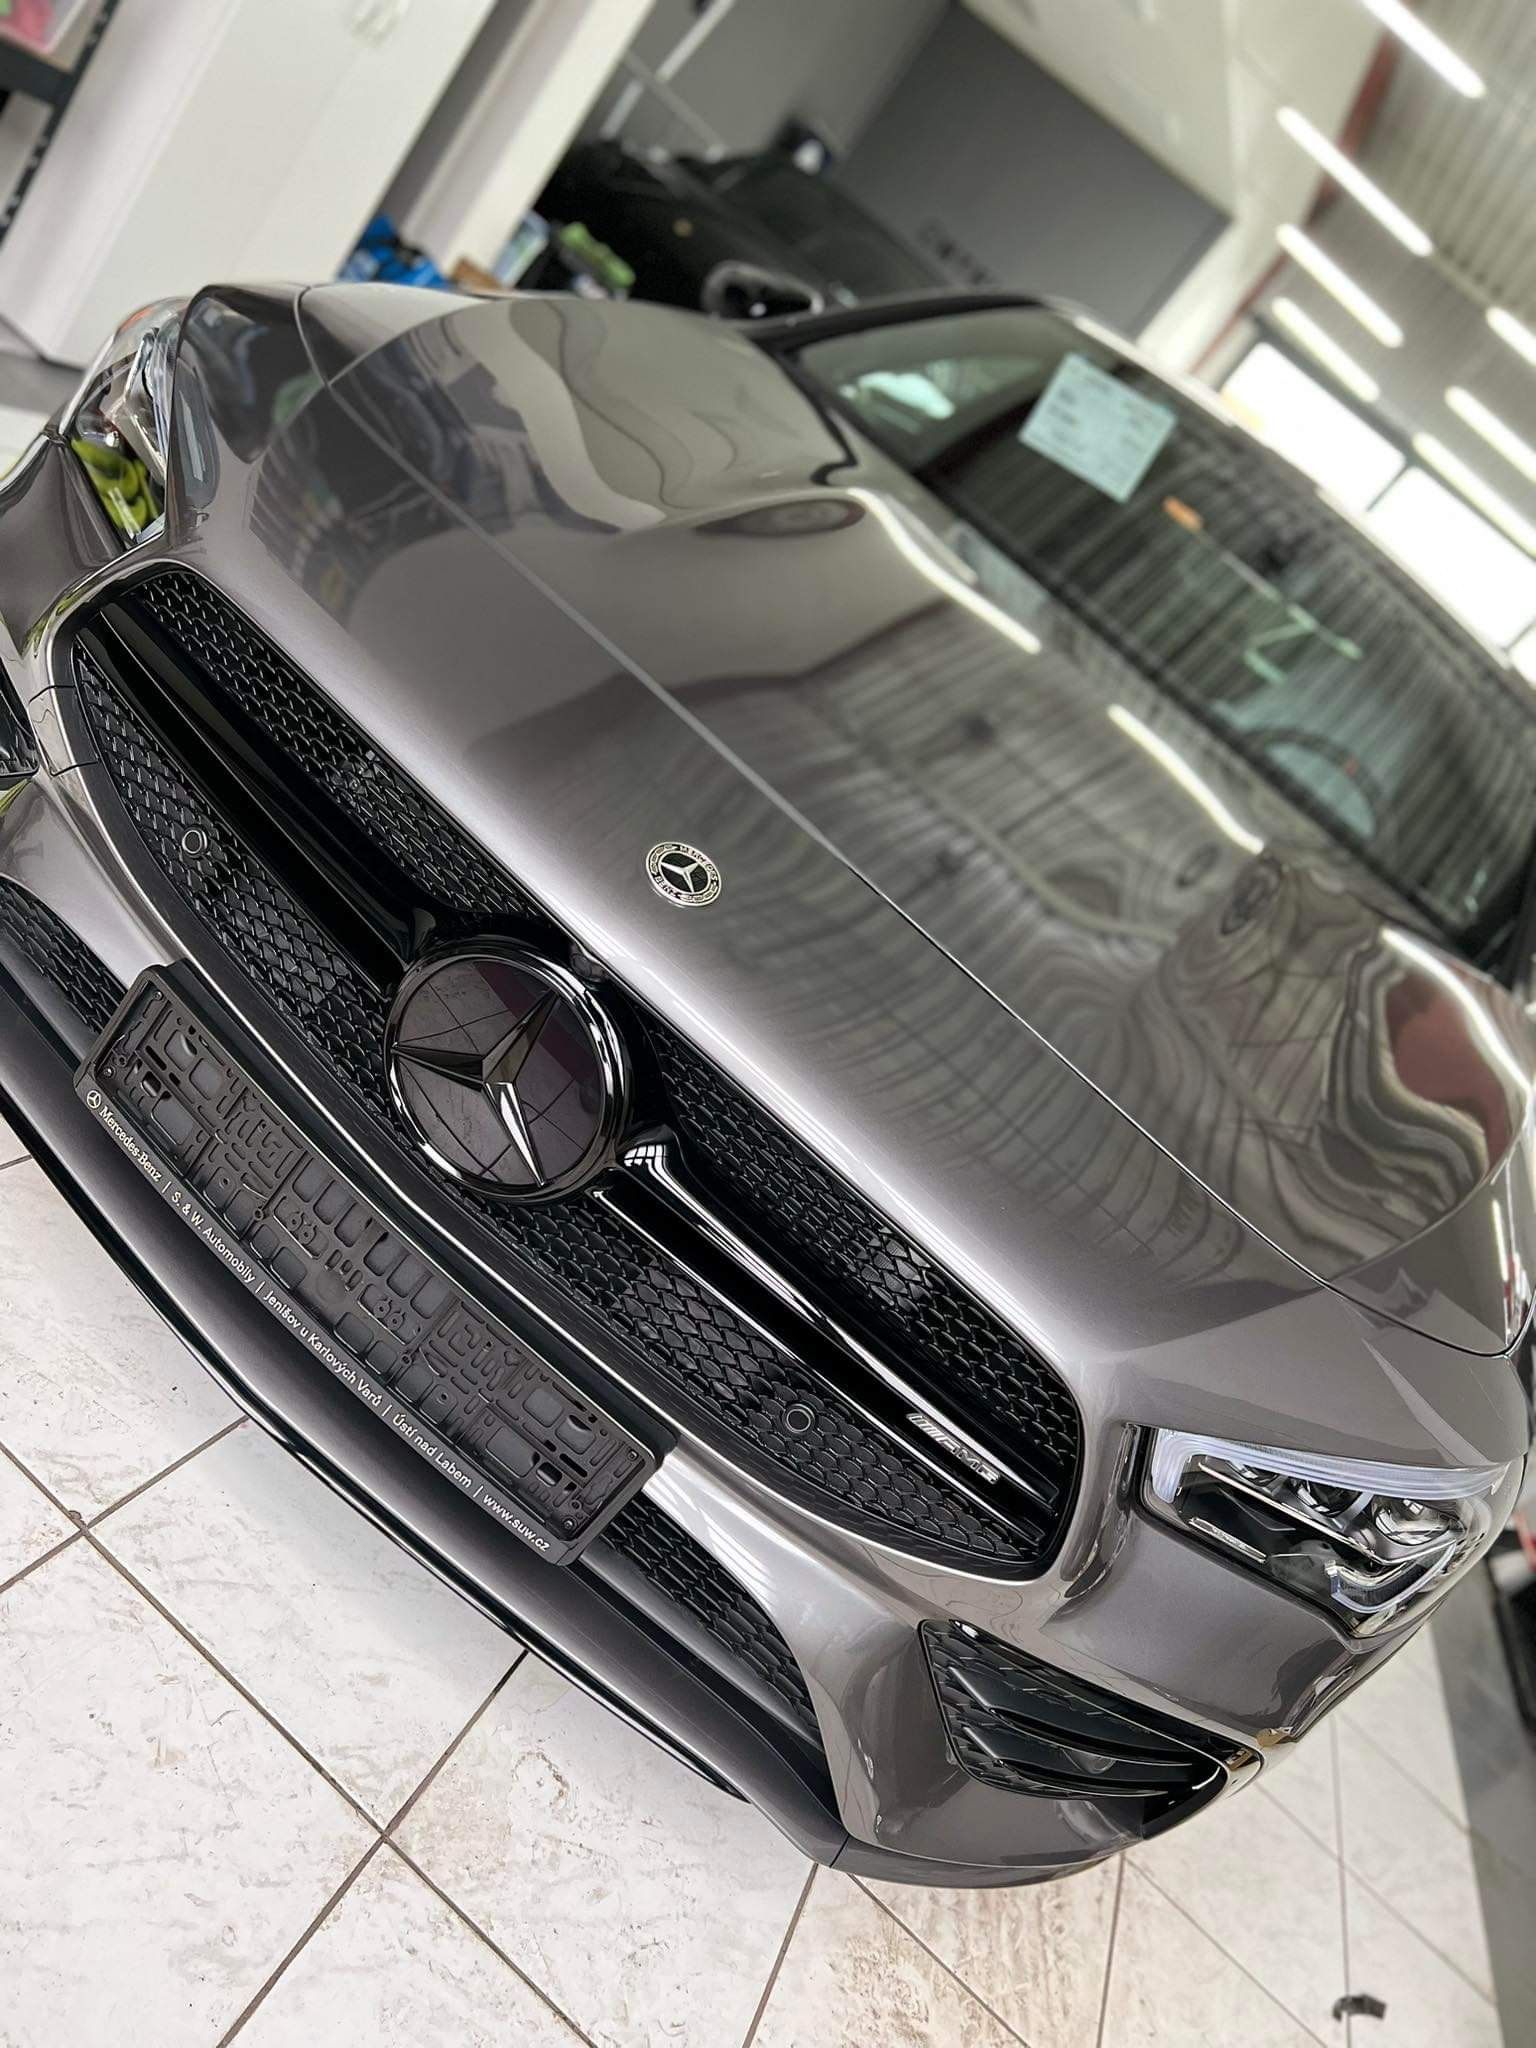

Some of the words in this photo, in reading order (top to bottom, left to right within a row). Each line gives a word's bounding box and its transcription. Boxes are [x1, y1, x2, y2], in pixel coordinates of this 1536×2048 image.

[99, 1106, 162, 1181] Mercedes-Benz
[182, 1203, 191, 1215] &
[203, 1227, 255, 1283] Automobily
[263, 1290, 301, 1328] Jenišov
[300, 1327, 310, 1338] u
[307, 1333, 357, 1384] Karlových
[357, 1379, 383, 1407] Varů
[392, 1414, 418, 1437] Ústí
[414, 1434, 438, 1457] nad
[435, 1452, 473, 1488] Labem
[483, 1494, 551, 1552] www.suw.cz
